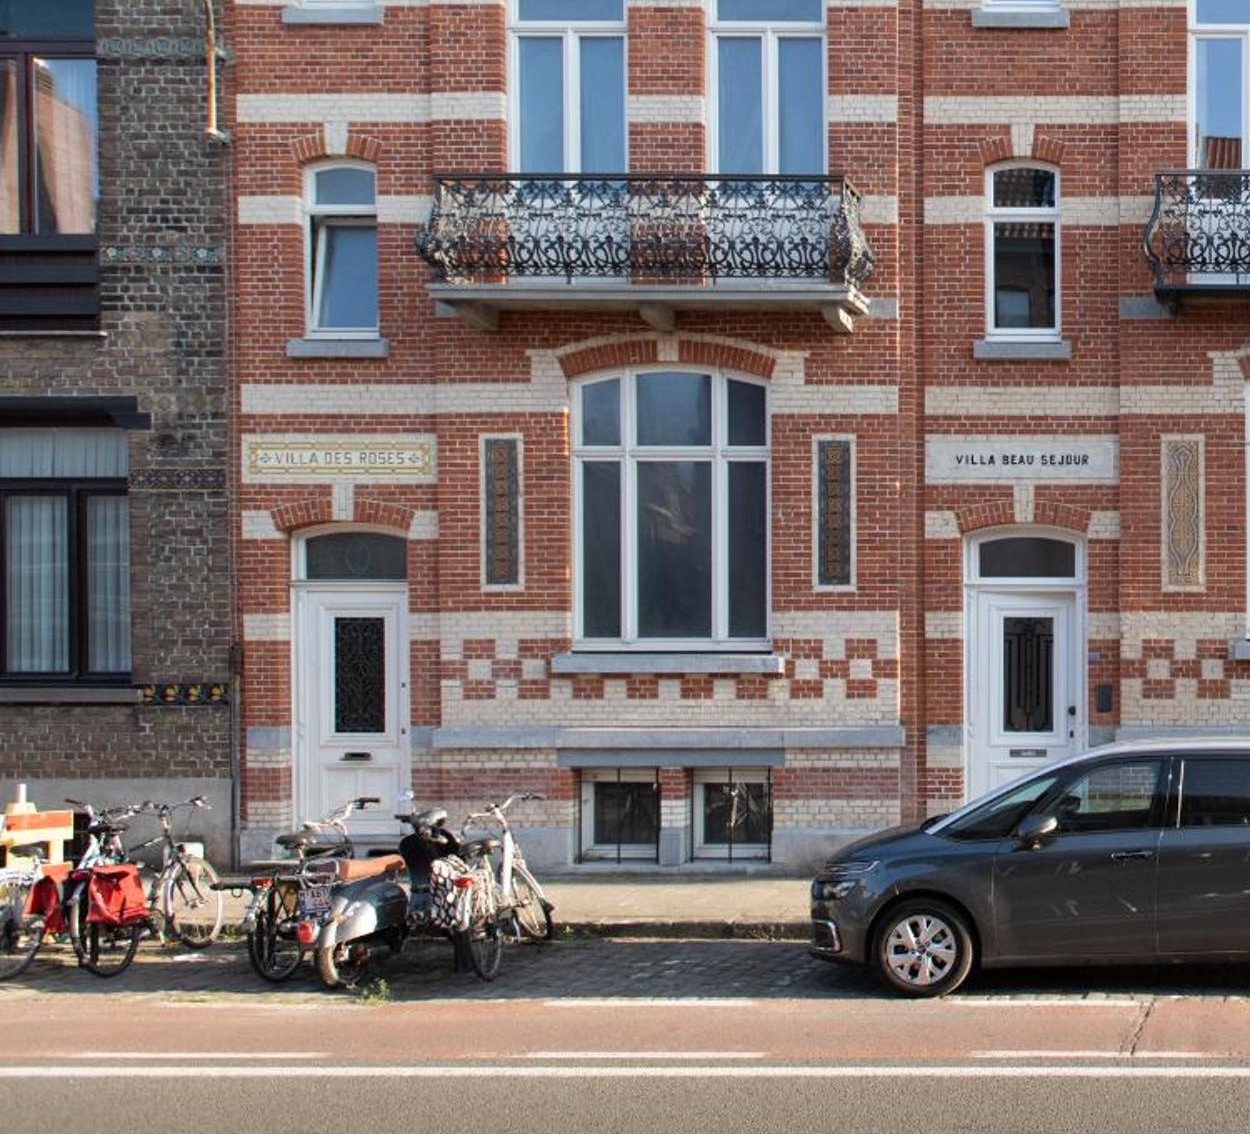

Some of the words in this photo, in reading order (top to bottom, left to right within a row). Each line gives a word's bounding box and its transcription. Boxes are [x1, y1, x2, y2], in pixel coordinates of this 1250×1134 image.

[274, 452, 319, 465] VILLA
[324, 452, 350, 465] DES
[359, 452, 405, 465] ROSES
[956, 454, 996, 465] VILLA
[1002, 454, 1034, 465] BEAU
[1041, 454, 1089, 465] SEJOUR
